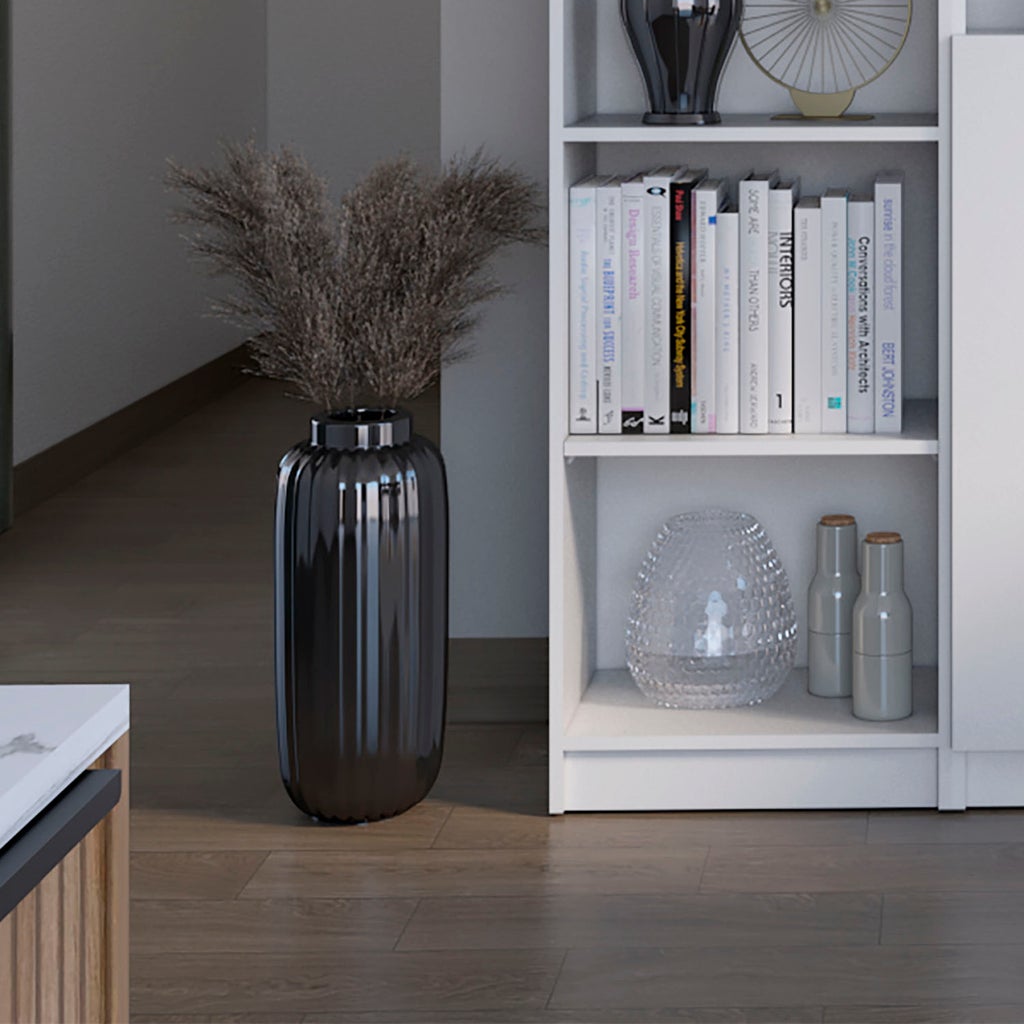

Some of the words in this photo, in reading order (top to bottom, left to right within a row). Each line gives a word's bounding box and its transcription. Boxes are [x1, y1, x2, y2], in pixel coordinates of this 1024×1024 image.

[675, 189, 685, 203] Paul
[748, 189, 760, 214] SOME
[675, 204, 685, 221] Shaw
[883, 199, 893, 231] sunrise
[626, 208, 640, 247] Design
[651, 206, 662, 253] ESSENTIALS
[748, 217, 760, 234] ARE
[651, 255, 662, 266] OF
[675, 241, 686, 271] Helvetica
[883, 240, 895, 256] the
[629, 249, 640, 300] Research
[651, 267, 662, 296] VISUAL
[675, 272, 686, 281] and
[748, 269, 760, 294] THAN
[779, 231, 792, 308] INTERIORS
[858, 236, 870, 312] Conversations
[883, 259, 895, 282] cloud
[603, 271, 615, 314] BLUEPRINT
[675, 282, 686, 293] the
[883, 284, 895, 310] forest
[675, 294, 686, 309] New
[748, 297, 760, 331] OTHERS
[675, 310, 686, 325] York
[858, 315, 870, 337] with
[651, 297, 662, 366] COMMUNICATION
[673, 326, 686, 338] City
[603, 331, 615, 363] SUCCESS
[673, 338, 686, 363] Subway
[882, 342, 894, 364] BERT
[673, 365, 686, 388] System
[858, 341, 870, 393] Architects
[882, 366, 894, 418] JOHNSTON
